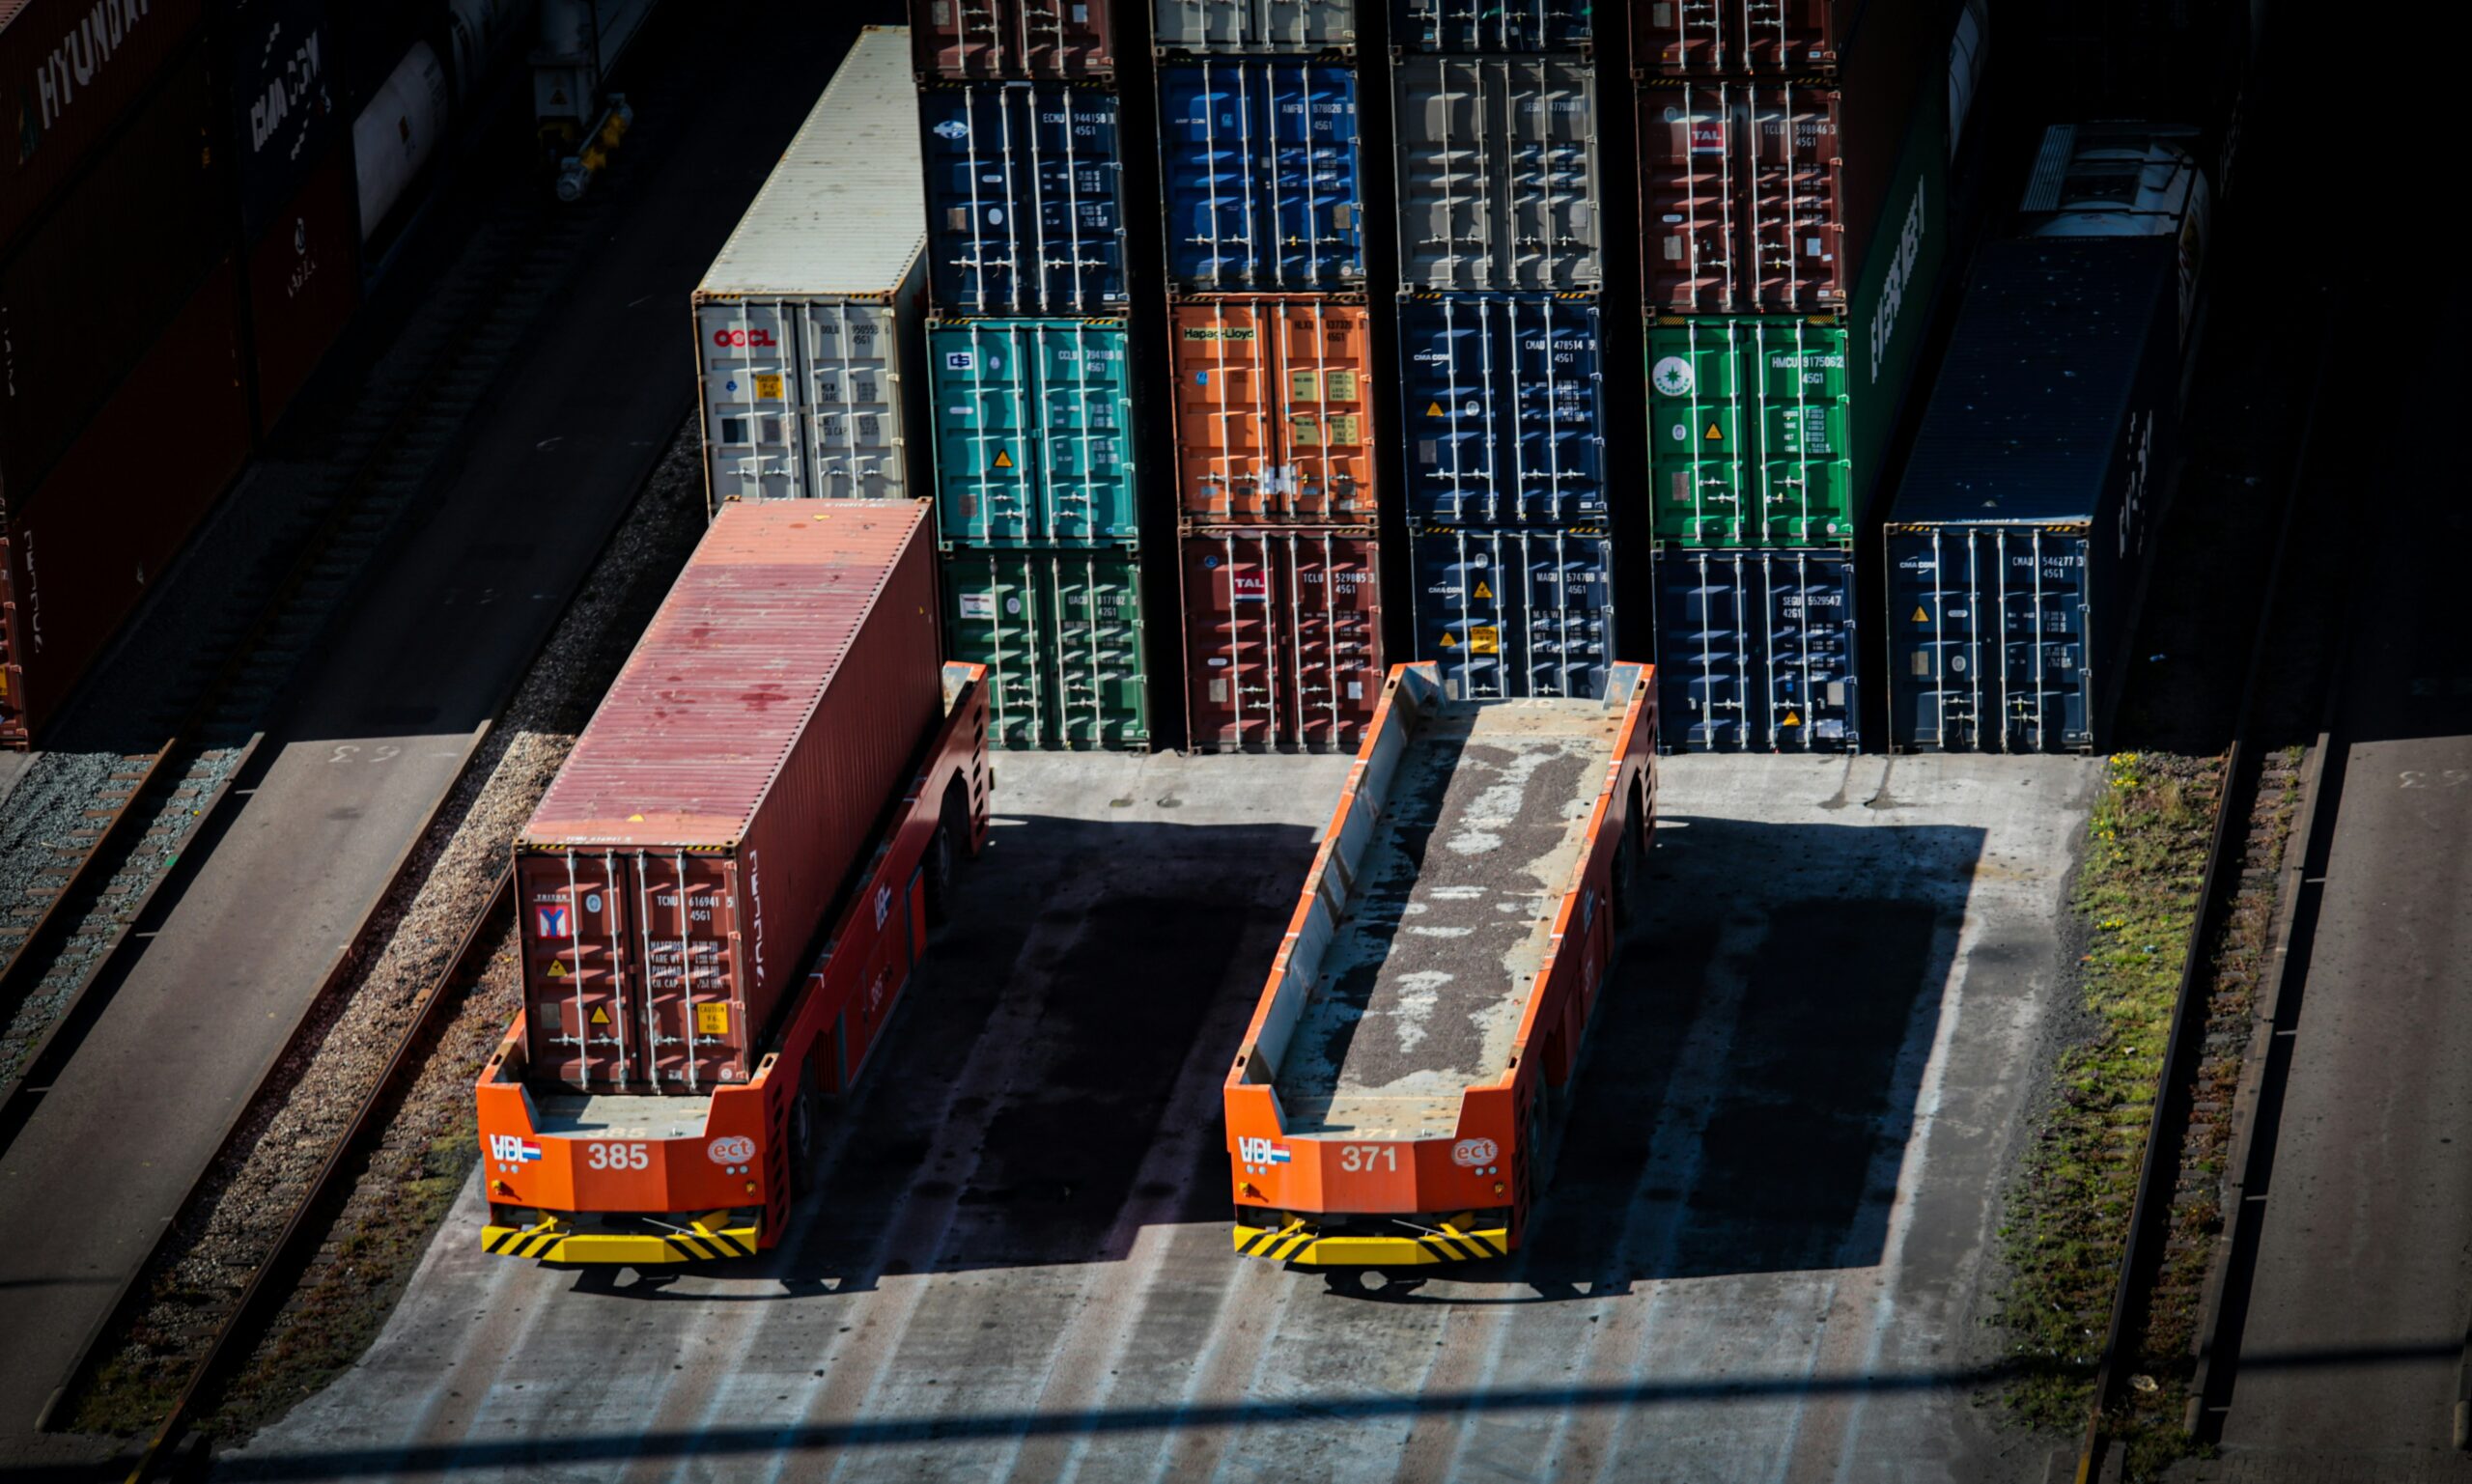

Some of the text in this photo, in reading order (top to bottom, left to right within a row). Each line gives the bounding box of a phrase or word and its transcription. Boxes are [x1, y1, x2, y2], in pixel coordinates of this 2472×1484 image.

[37, 0, 149, 129] HYUNDA
[1691, 130, 1723, 141] TAL
[713, 329, 776, 348] OOCL
[1184, 328, 1254, 341] Hapag-Lloyd
[1525, 339, 1546, 350] CMAU
[1554, 339, 1583, 350] 478514
[1554, 351, 1574, 363] 45G1
[1772, 356, 1799, 368] HMCU
[1802, 372, 1824, 383] 45G1
[2012, 555, 2034, 567] CMAU
[2042, 556, 2073, 567] 546277
[2043, 568, 2064, 578] 45G1
[1234, 577, 1264, 588] TAL
[1335, 584, 1356, 594] 45G1
[1783, 596, 1802, 606] SEGU
[1783, 607, 1803, 618] 42G1
[688, 896, 719, 908] 616941
[689, 910, 711, 920] 45G1
[490, 1134, 528, 1162] VDL
[713, 1139, 751, 1159] ect
[1238, 1135, 1278, 1165] VDL
[1456, 1141, 1494, 1161] ect
[588, 1142, 649, 1170] 385
[1341, 1145, 1397, 1172] 371
